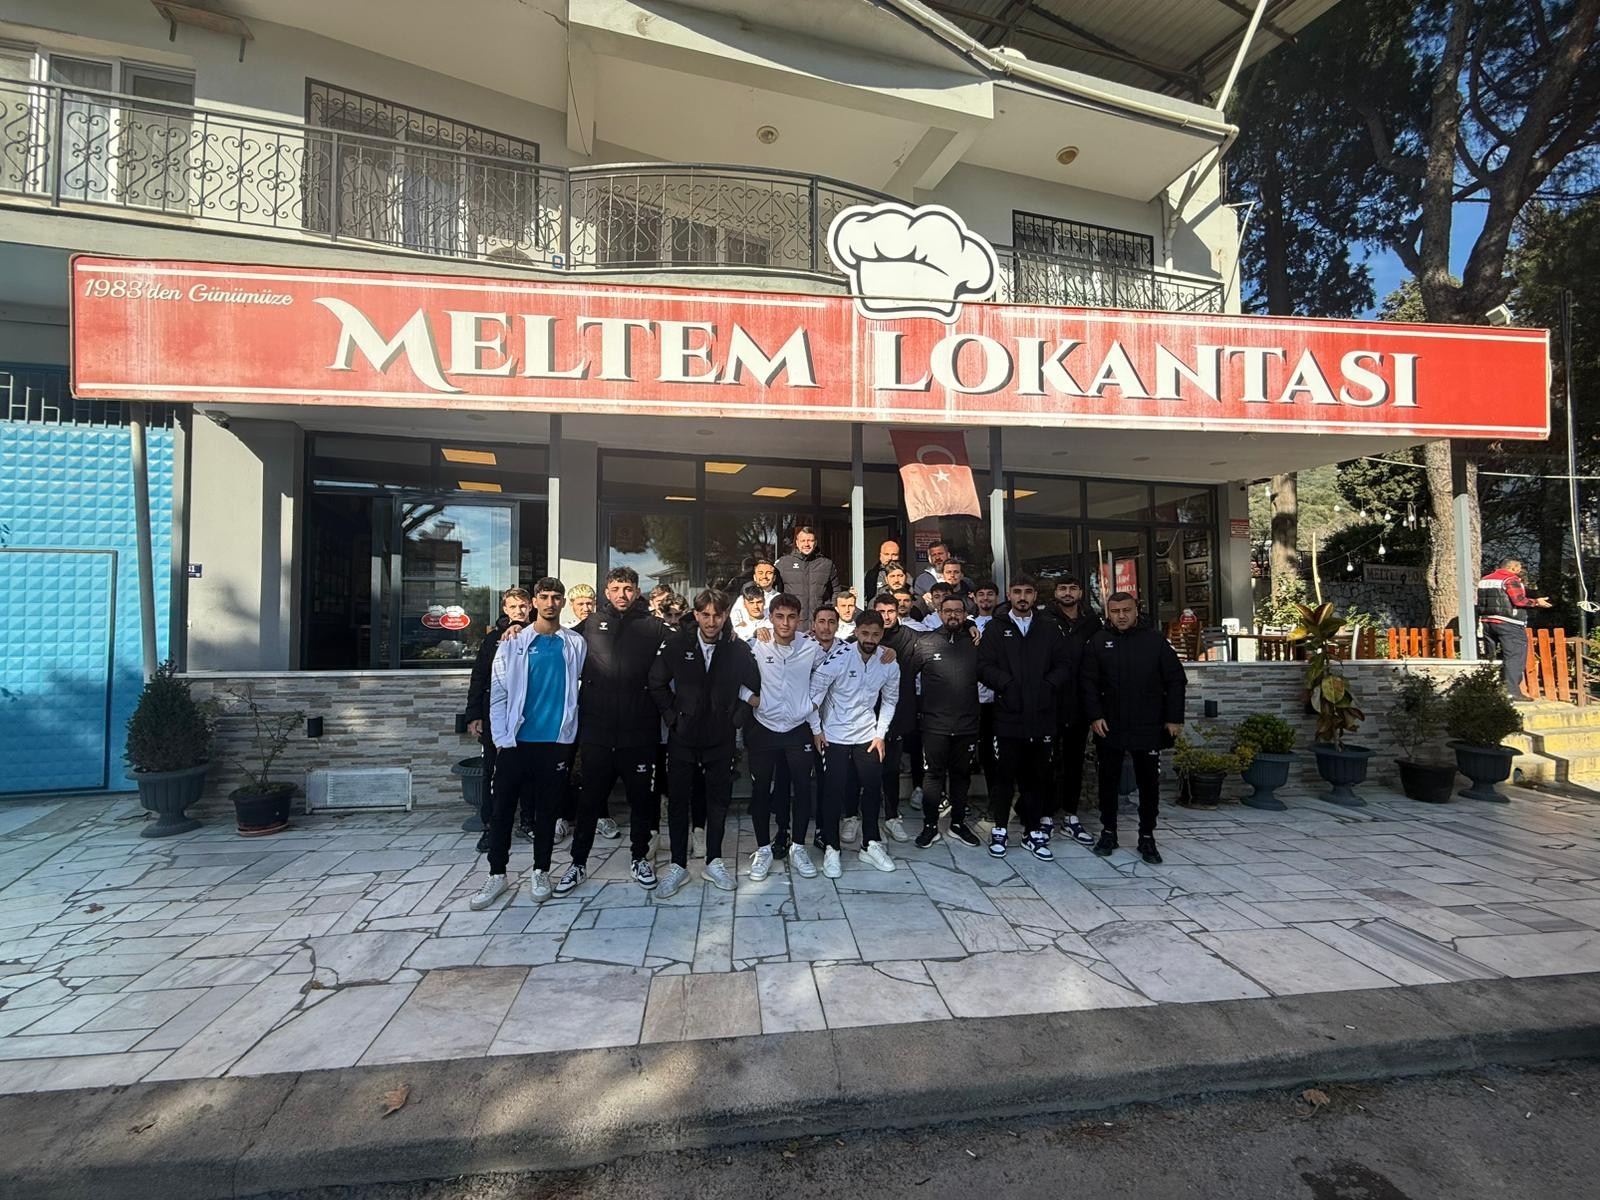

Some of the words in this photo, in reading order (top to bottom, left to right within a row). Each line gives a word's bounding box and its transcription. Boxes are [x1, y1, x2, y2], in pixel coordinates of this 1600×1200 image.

[84, 278, 183, 301] 1983'den
[188, 284, 294, 306] Günümüze
[312, 297, 818, 394] MELTEM
[869, 329, 1419, 408] LOKANTASI
